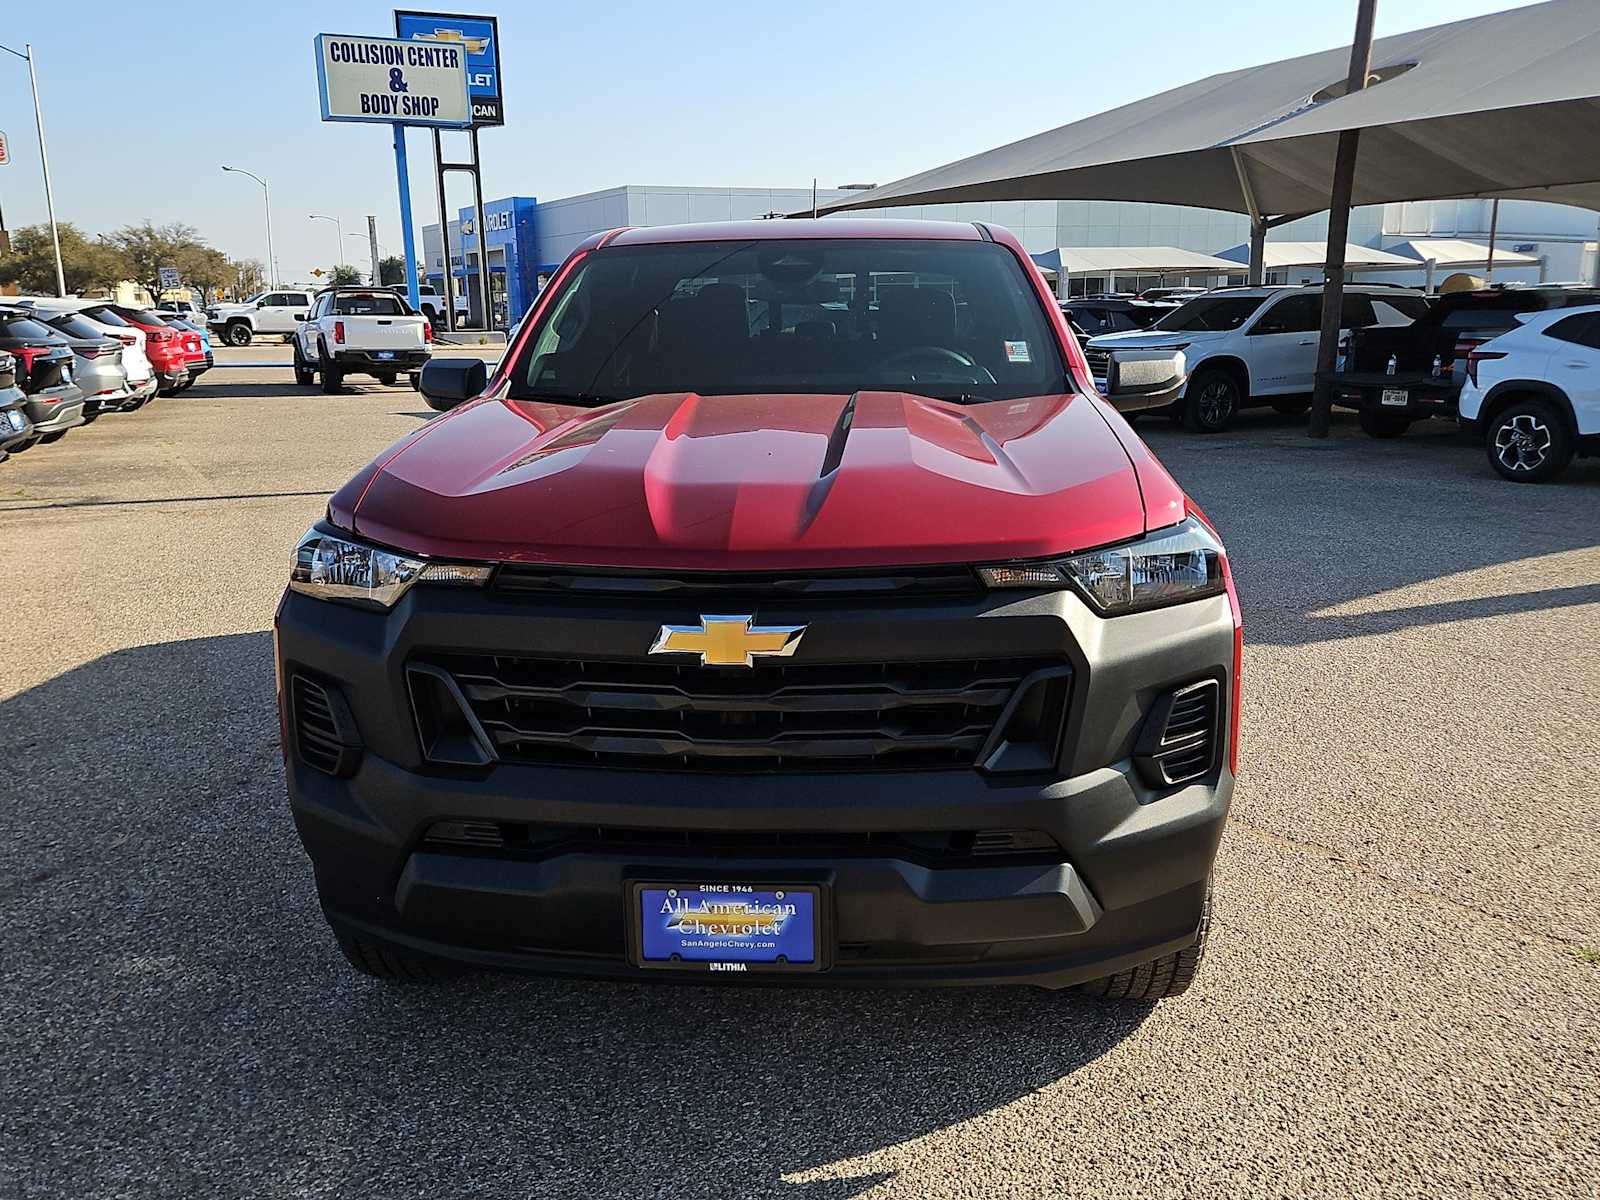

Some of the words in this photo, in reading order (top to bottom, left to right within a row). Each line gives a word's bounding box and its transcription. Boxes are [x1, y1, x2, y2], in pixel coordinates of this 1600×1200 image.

[330, 41, 405, 66] COLLISION
[407, 46, 459, 69] CENTER
[389, 67, 408, 93] &
[360, 93, 398, 115] BODY
[402, 95, 439, 117] SHOP
[163, 279, 179, 288] 35
[699, 884, 729, 893] SINCE
[732, 885, 753, 893] 1946
[660, 897, 689, 914] All
[699, 899, 797, 915] American
[678, 919, 782, 936] Chevrolet
[681, 939, 776, 949] SanAngeloChevy.com
